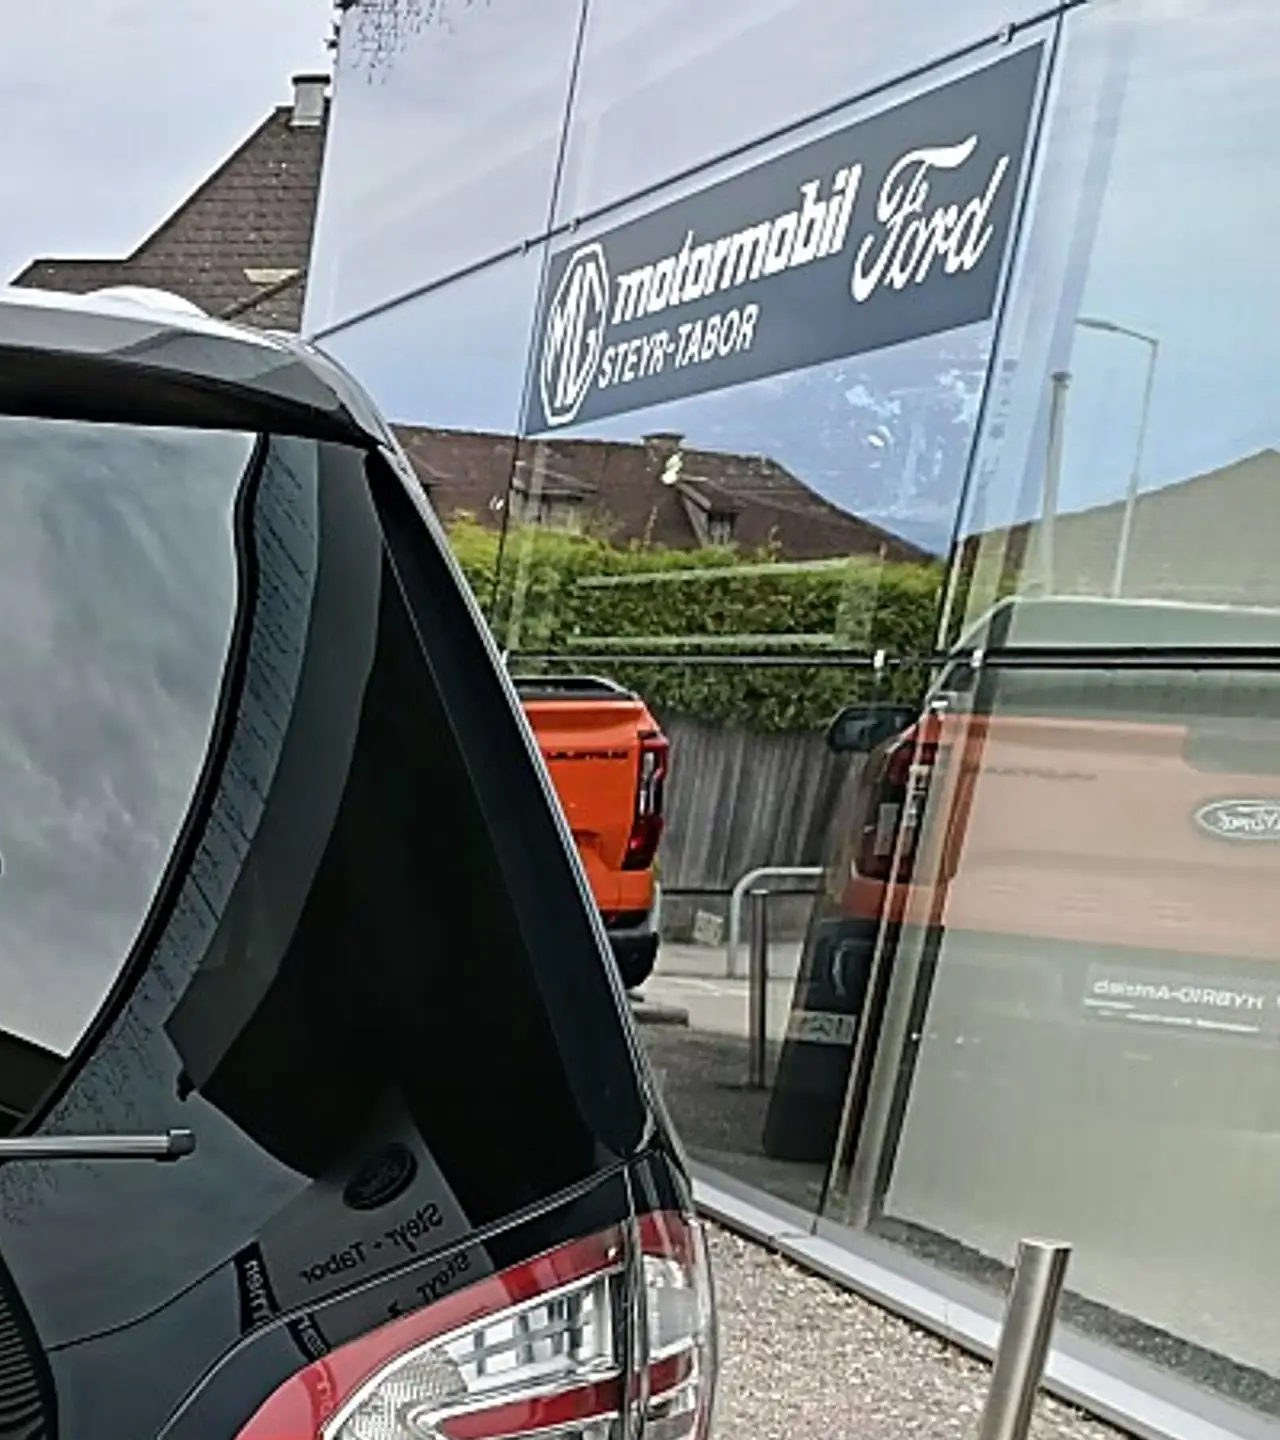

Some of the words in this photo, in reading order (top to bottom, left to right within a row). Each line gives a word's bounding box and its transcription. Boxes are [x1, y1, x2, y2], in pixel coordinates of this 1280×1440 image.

[611, 163, 862, 326] motormobil
[849, 134, 1010, 303] Ford
[546, 260, 607, 410] MG
[598, 303, 760, 389] STEYR-TABOR
